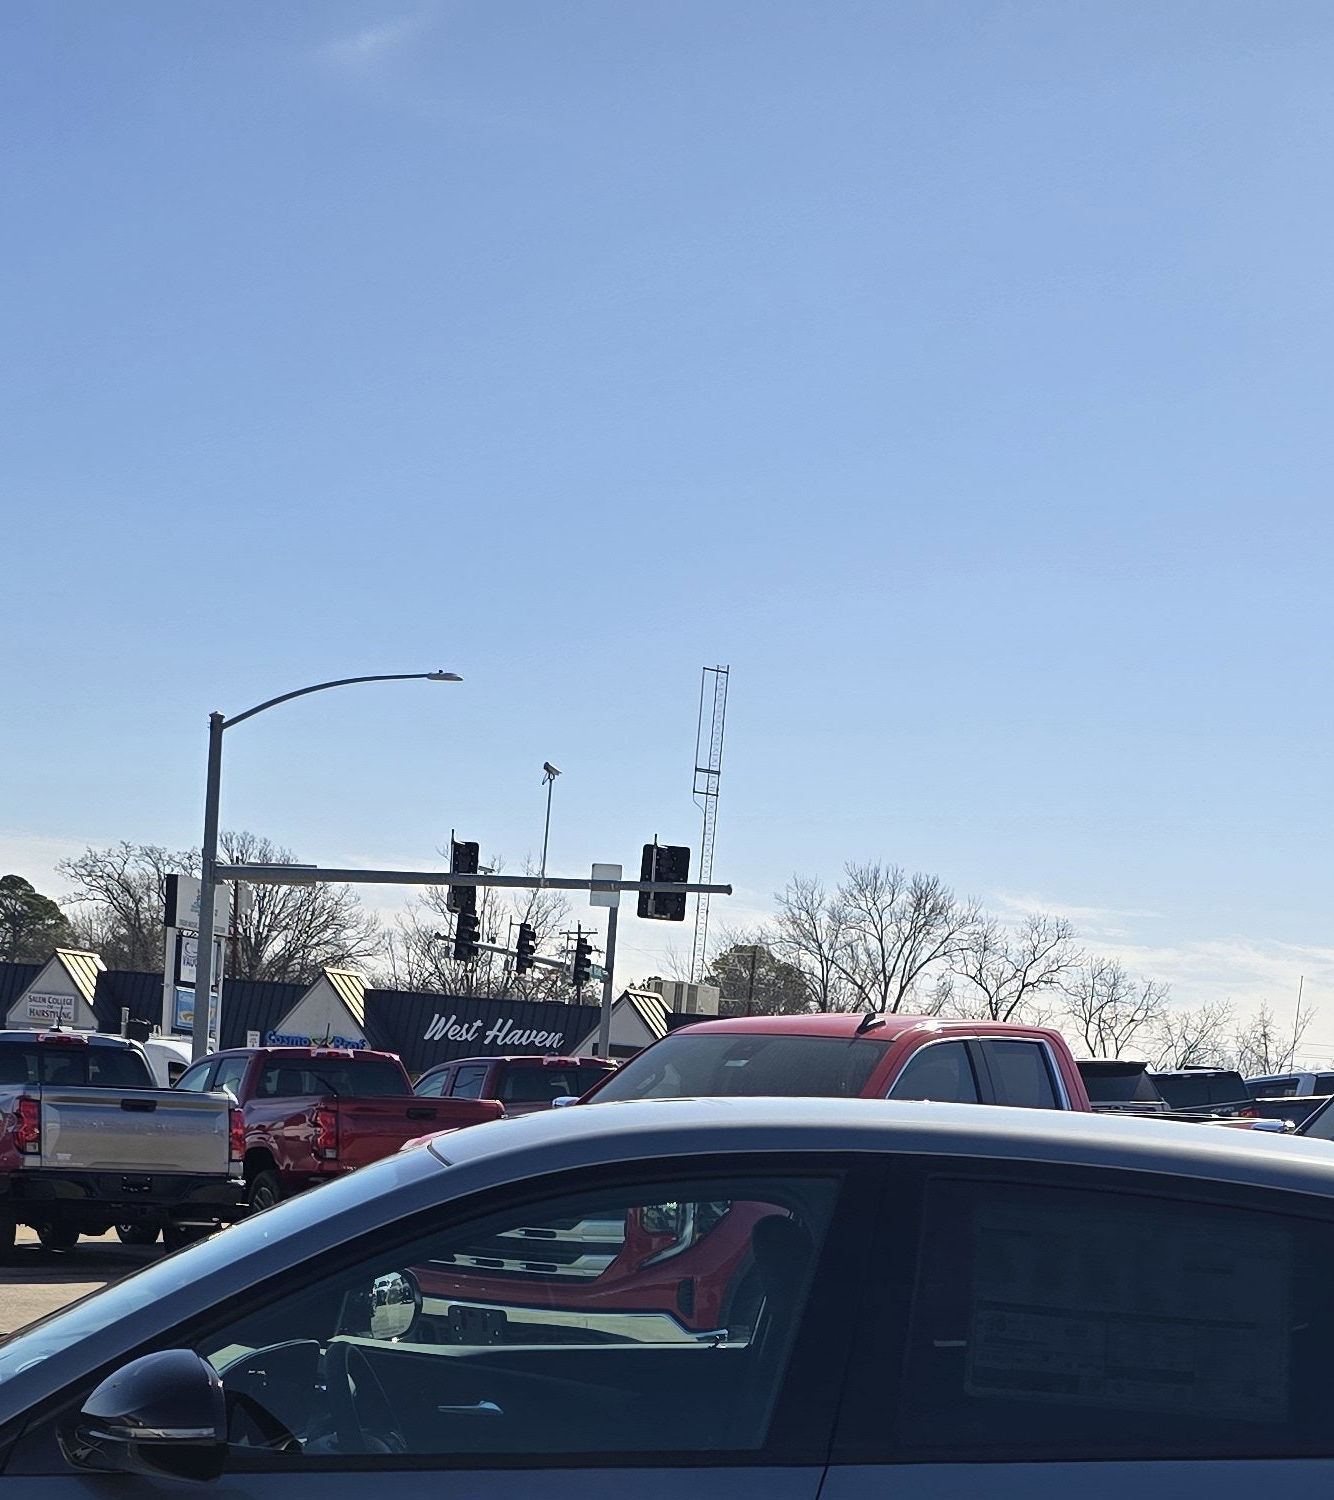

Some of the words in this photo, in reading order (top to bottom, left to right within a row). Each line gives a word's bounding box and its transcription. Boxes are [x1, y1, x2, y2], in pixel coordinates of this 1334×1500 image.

[28, 994, 47, 1004] SALEM
[48, 996, 73, 1006] COLLEGE
[29, 1008, 72, 1019] HAIRSTYLNG
[424, 1013, 483, 1041] West
[483, 1018, 564, 1048] Haven
[267, 1030, 310, 1047] Cosmo
